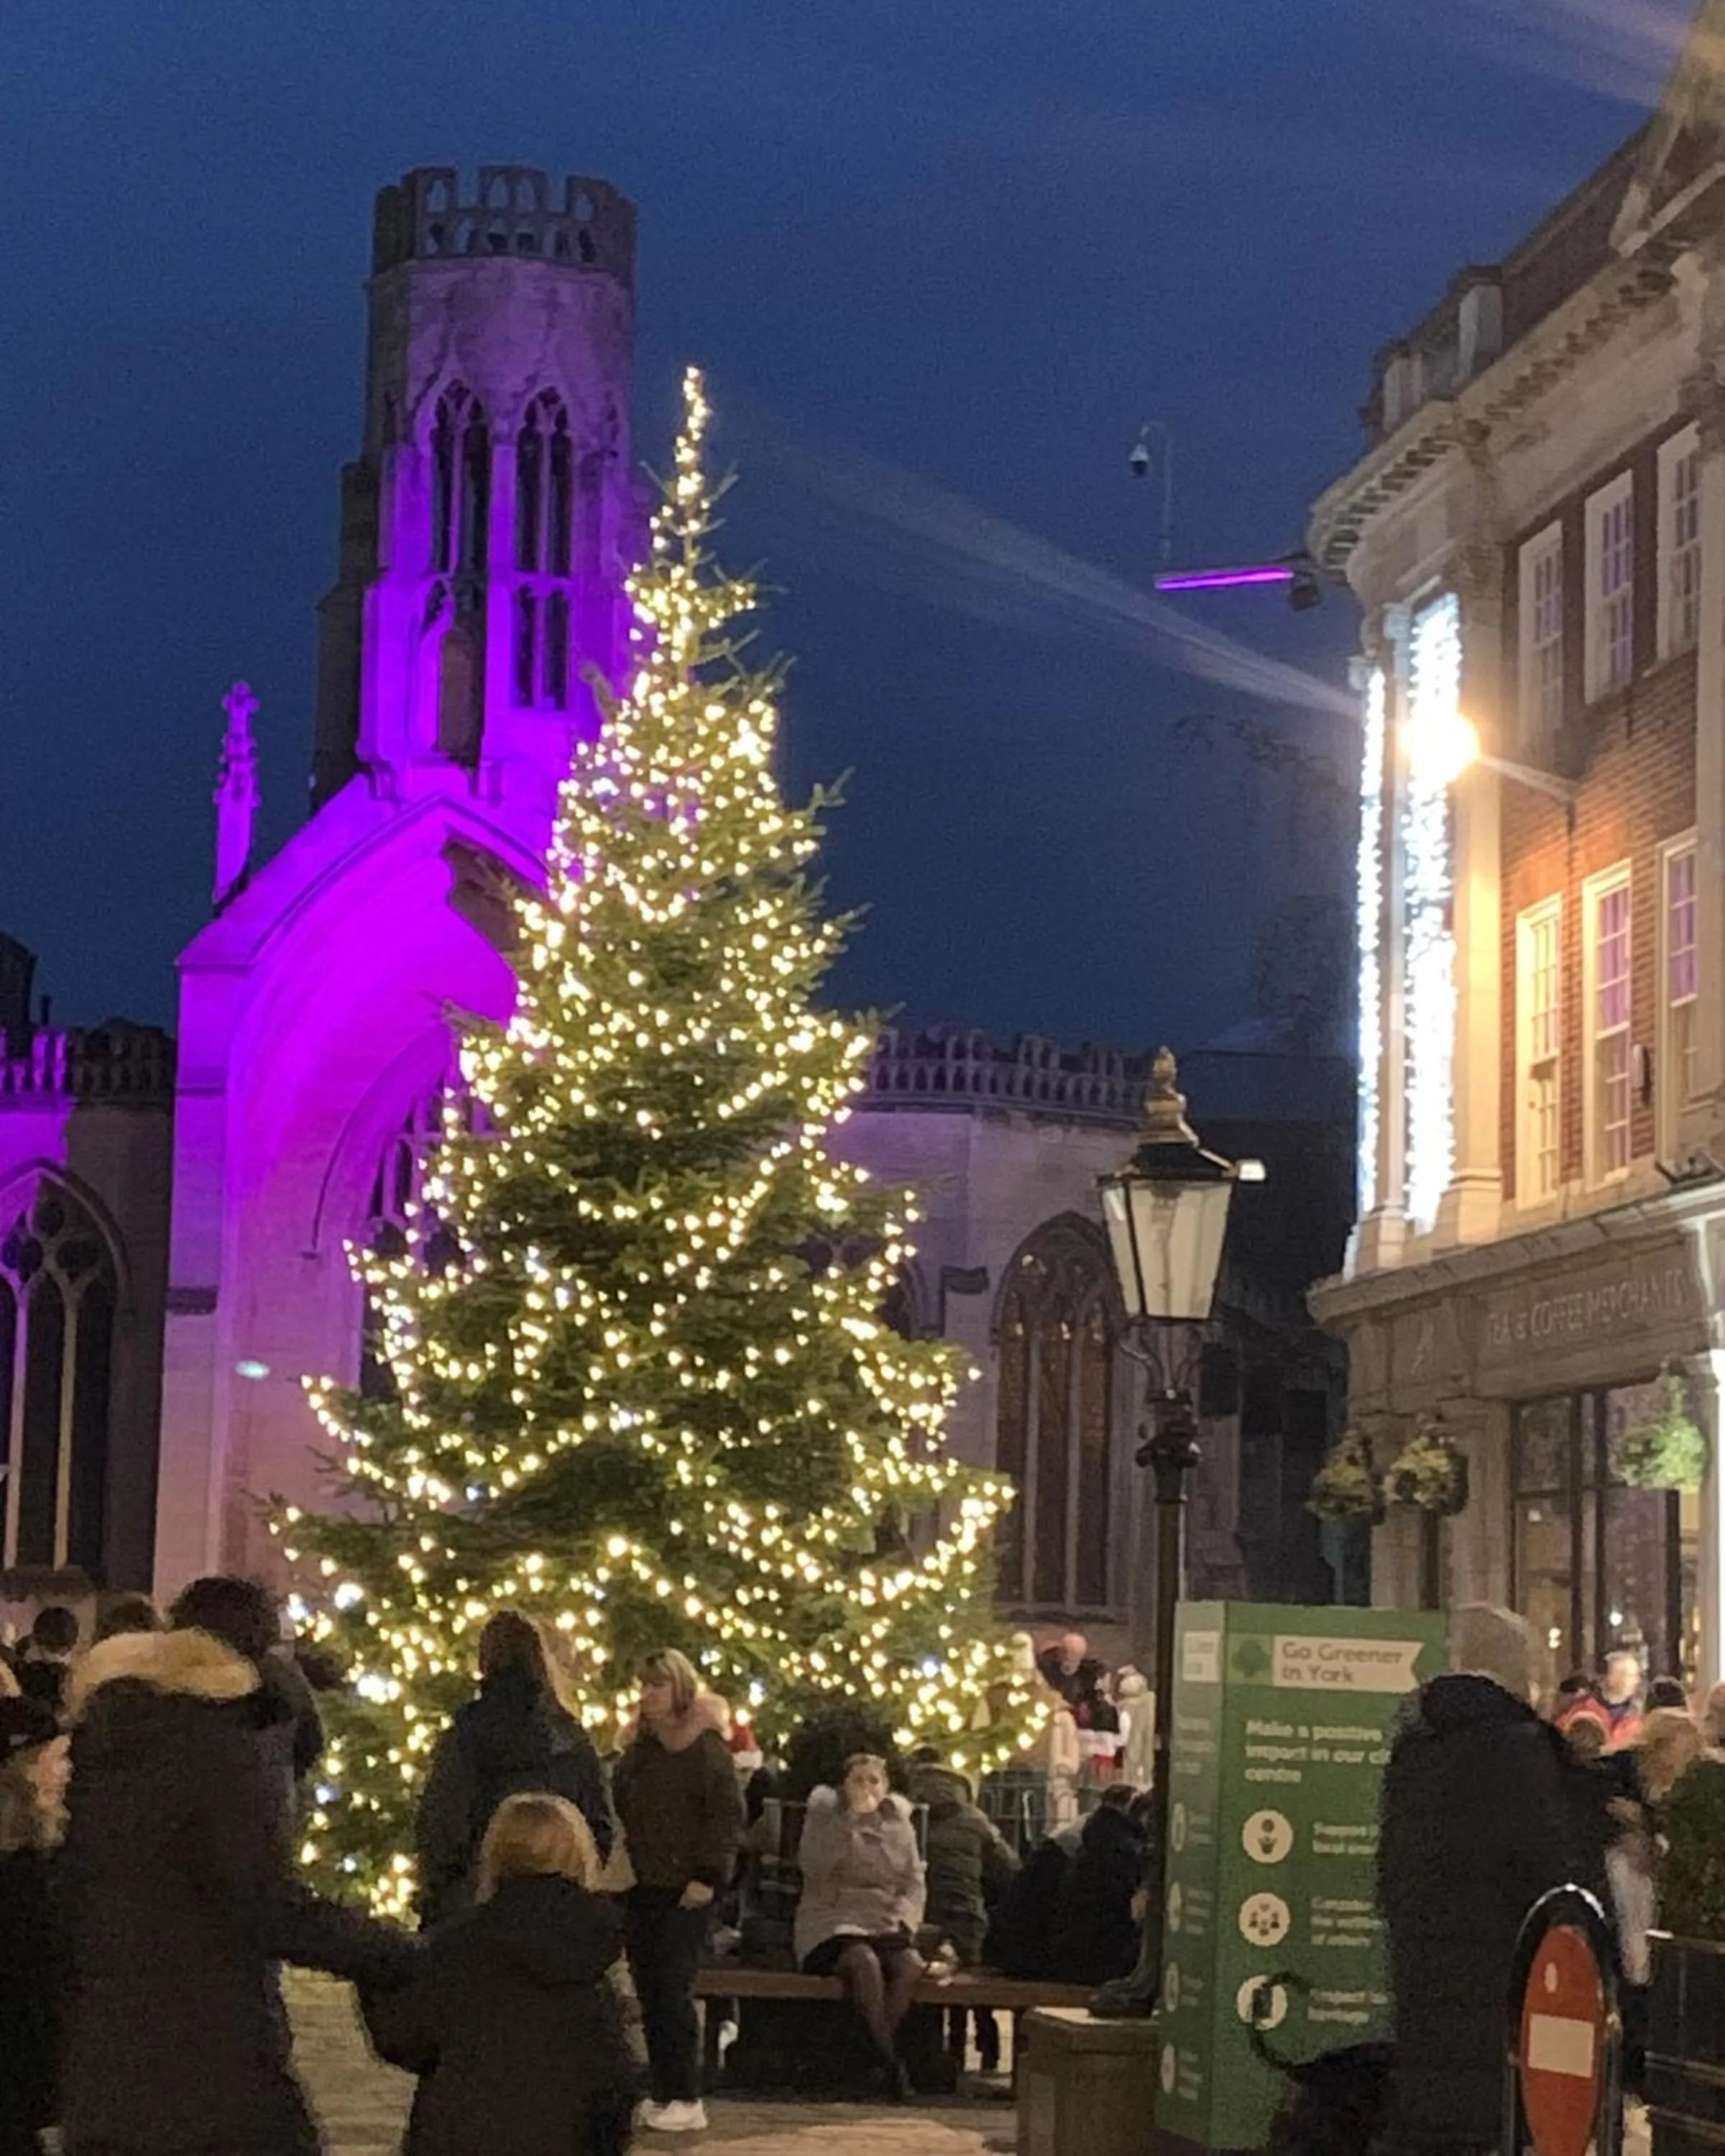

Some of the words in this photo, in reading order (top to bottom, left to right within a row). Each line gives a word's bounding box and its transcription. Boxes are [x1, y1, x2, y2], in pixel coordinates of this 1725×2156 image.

[1531, 1291, 1582, 1337] COFFEE
[1282, 1641, 1312, 1659] Go
[1318, 1642, 1403, 1664] Greener
[1308, 1665, 1354, 1684] York
